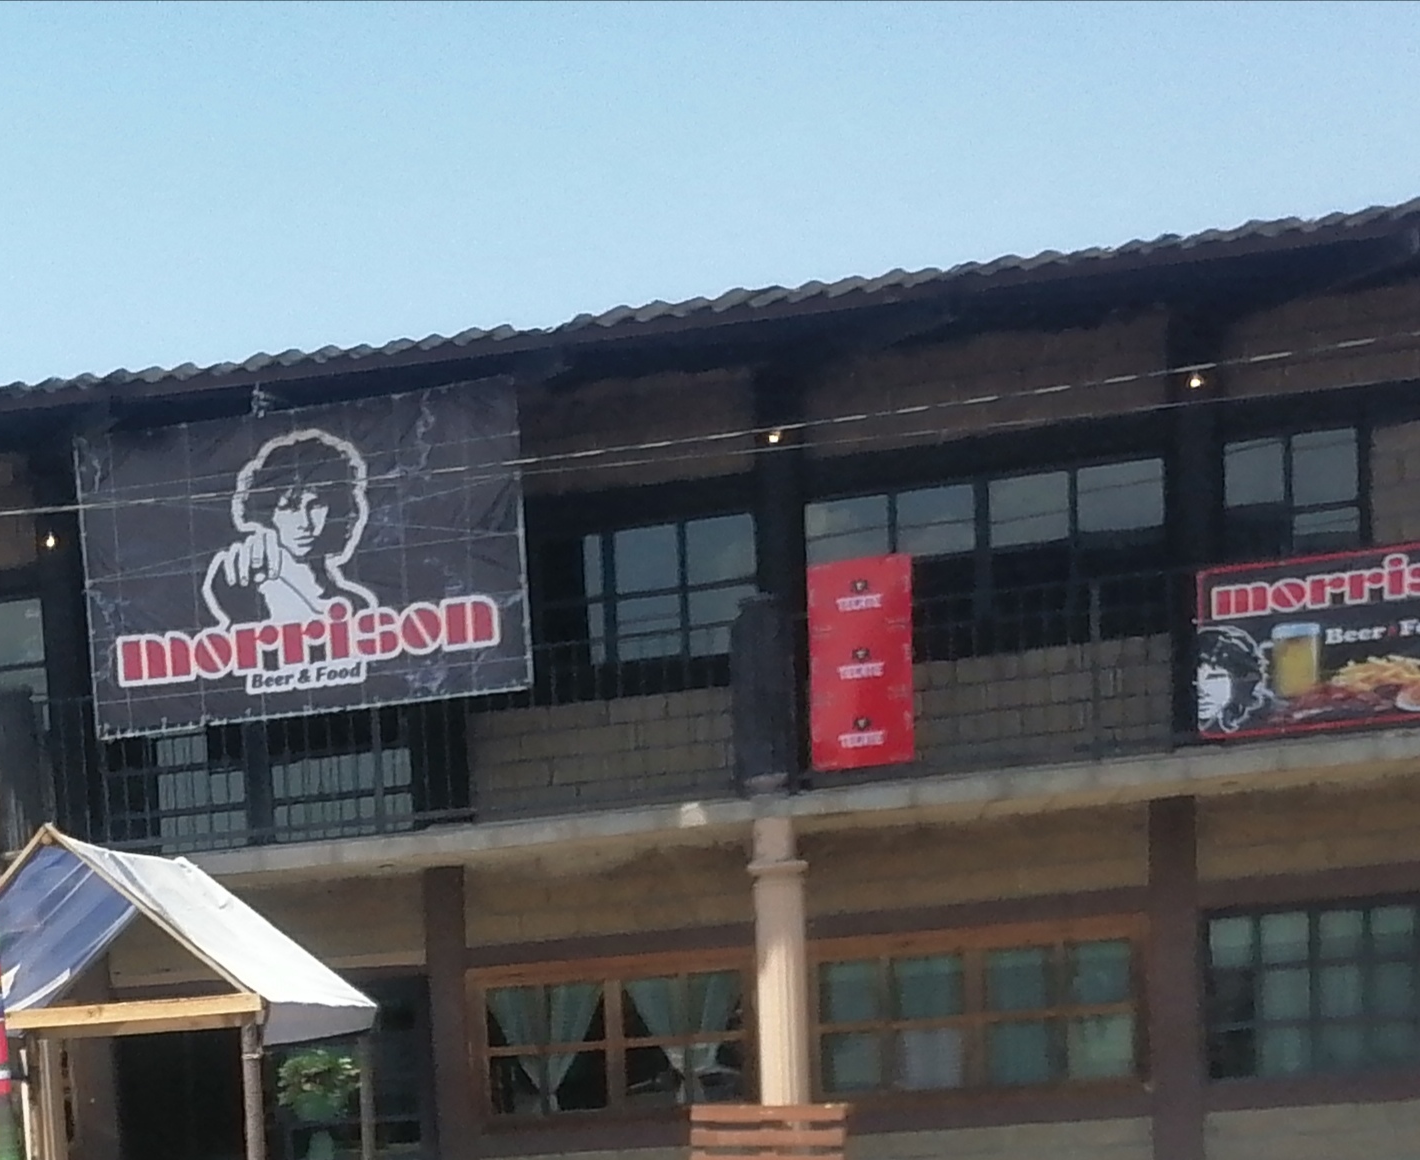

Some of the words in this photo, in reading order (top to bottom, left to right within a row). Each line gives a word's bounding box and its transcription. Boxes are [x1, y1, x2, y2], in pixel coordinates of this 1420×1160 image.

[118, 598, 498, 685] morrison
[1325, 627, 1386, 644] Beer
[1399, 618, 1420, 637] F
[251, 673, 295, 689] Beer
[297, 668, 311, 684] &
[315, 661, 362, 682] Food
